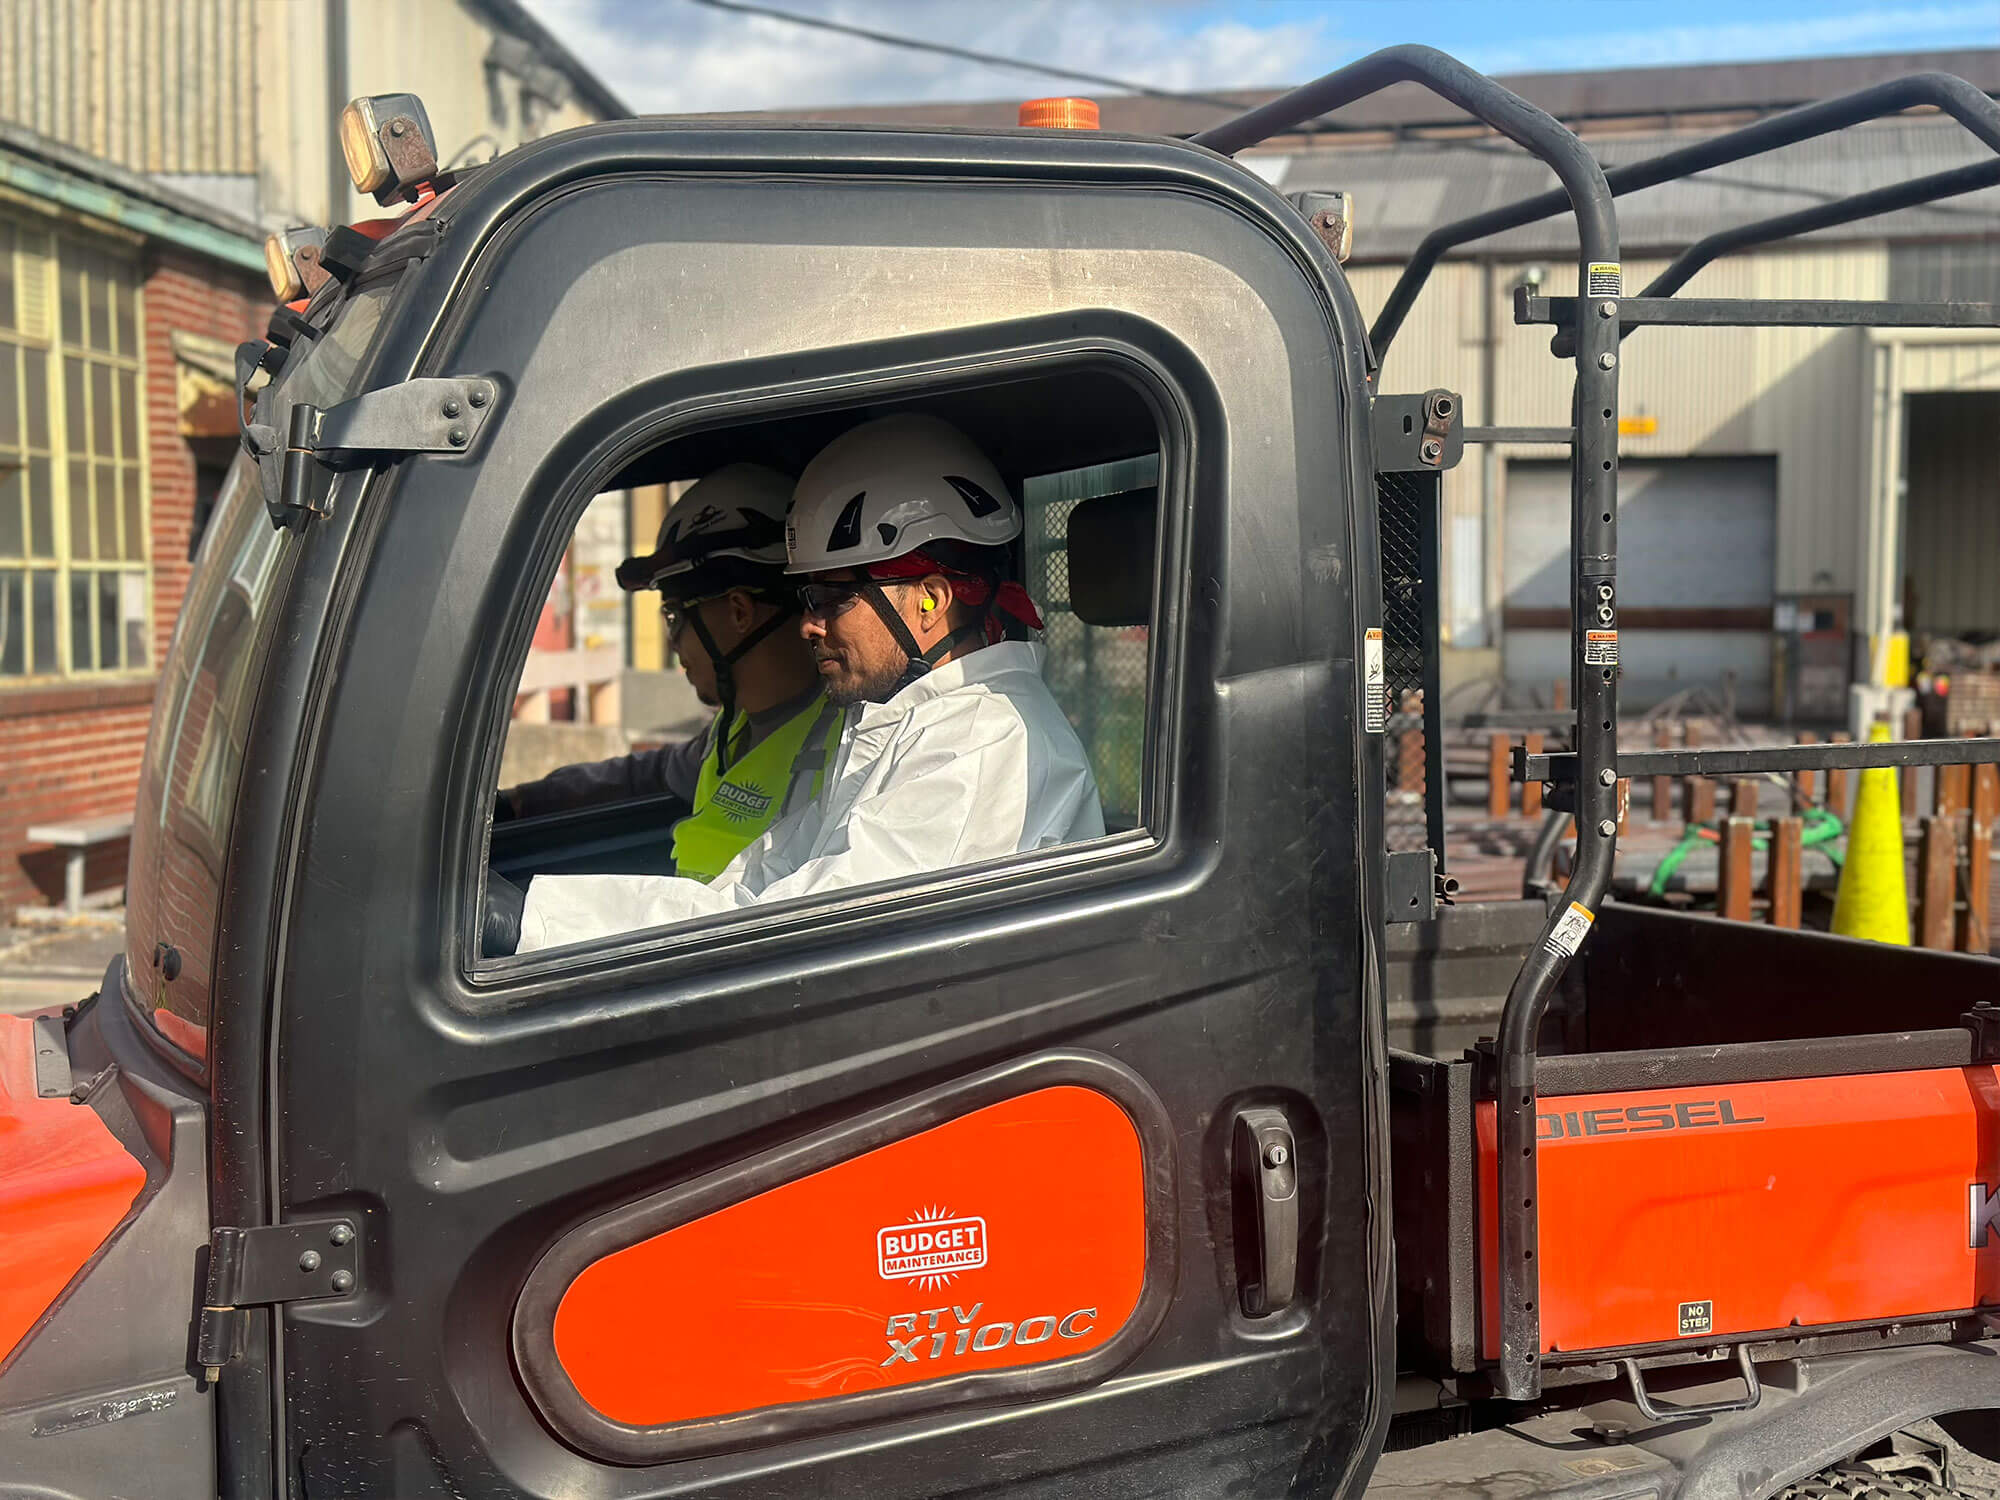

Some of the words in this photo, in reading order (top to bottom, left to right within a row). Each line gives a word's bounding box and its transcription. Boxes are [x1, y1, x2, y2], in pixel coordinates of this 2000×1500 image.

[718, 784, 769, 809] BUDGET
[885, 1226, 979, 1256] BUDGET
[886, 1249, 981, 1271] MAINTENANCE
[886, 1302, 984, 1336] RTV
[1681, 1317, 1710, 1329] STEP
[1688, 1306, 1704, 1317] NO
[879, 1306, 1098, 1368] X1100C
